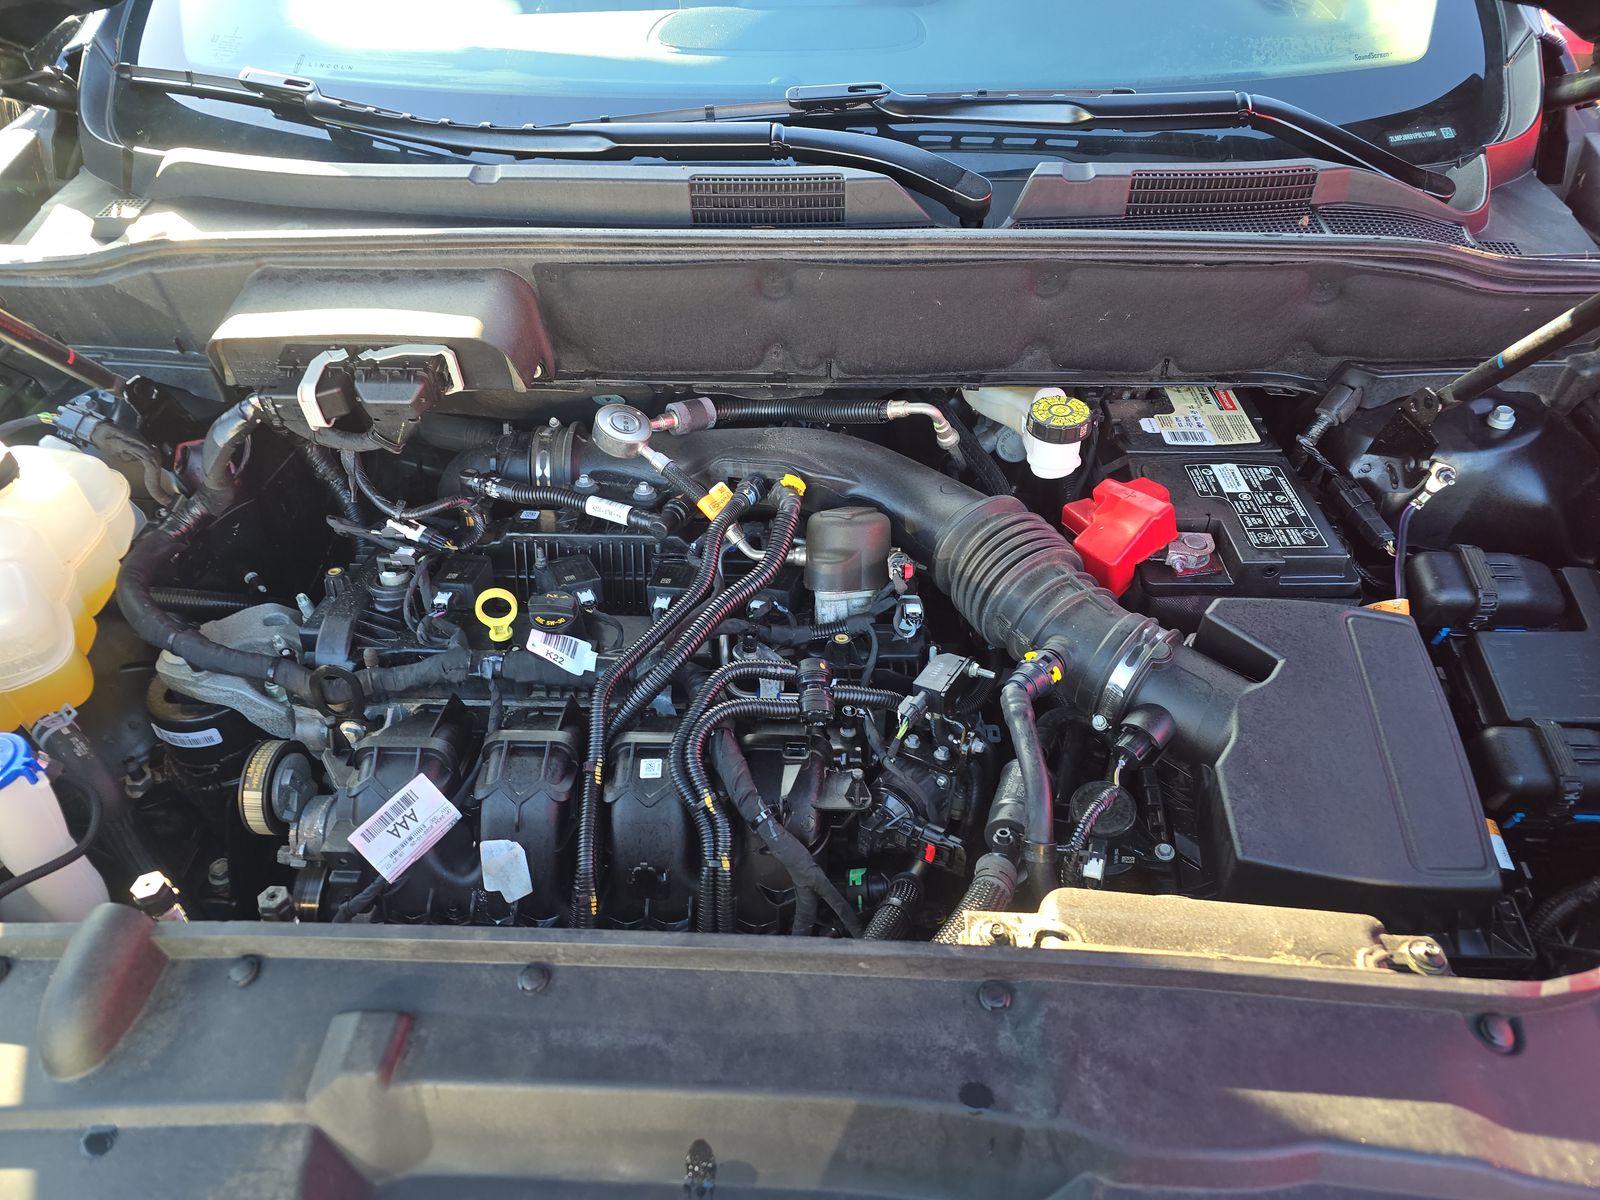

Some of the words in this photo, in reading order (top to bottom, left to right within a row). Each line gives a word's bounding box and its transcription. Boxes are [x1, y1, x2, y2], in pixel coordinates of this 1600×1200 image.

[307, 62, 354, 71] LINCOLN
[545, 649, 565, 665] K22
[386, 808, 419, 839] AAA
